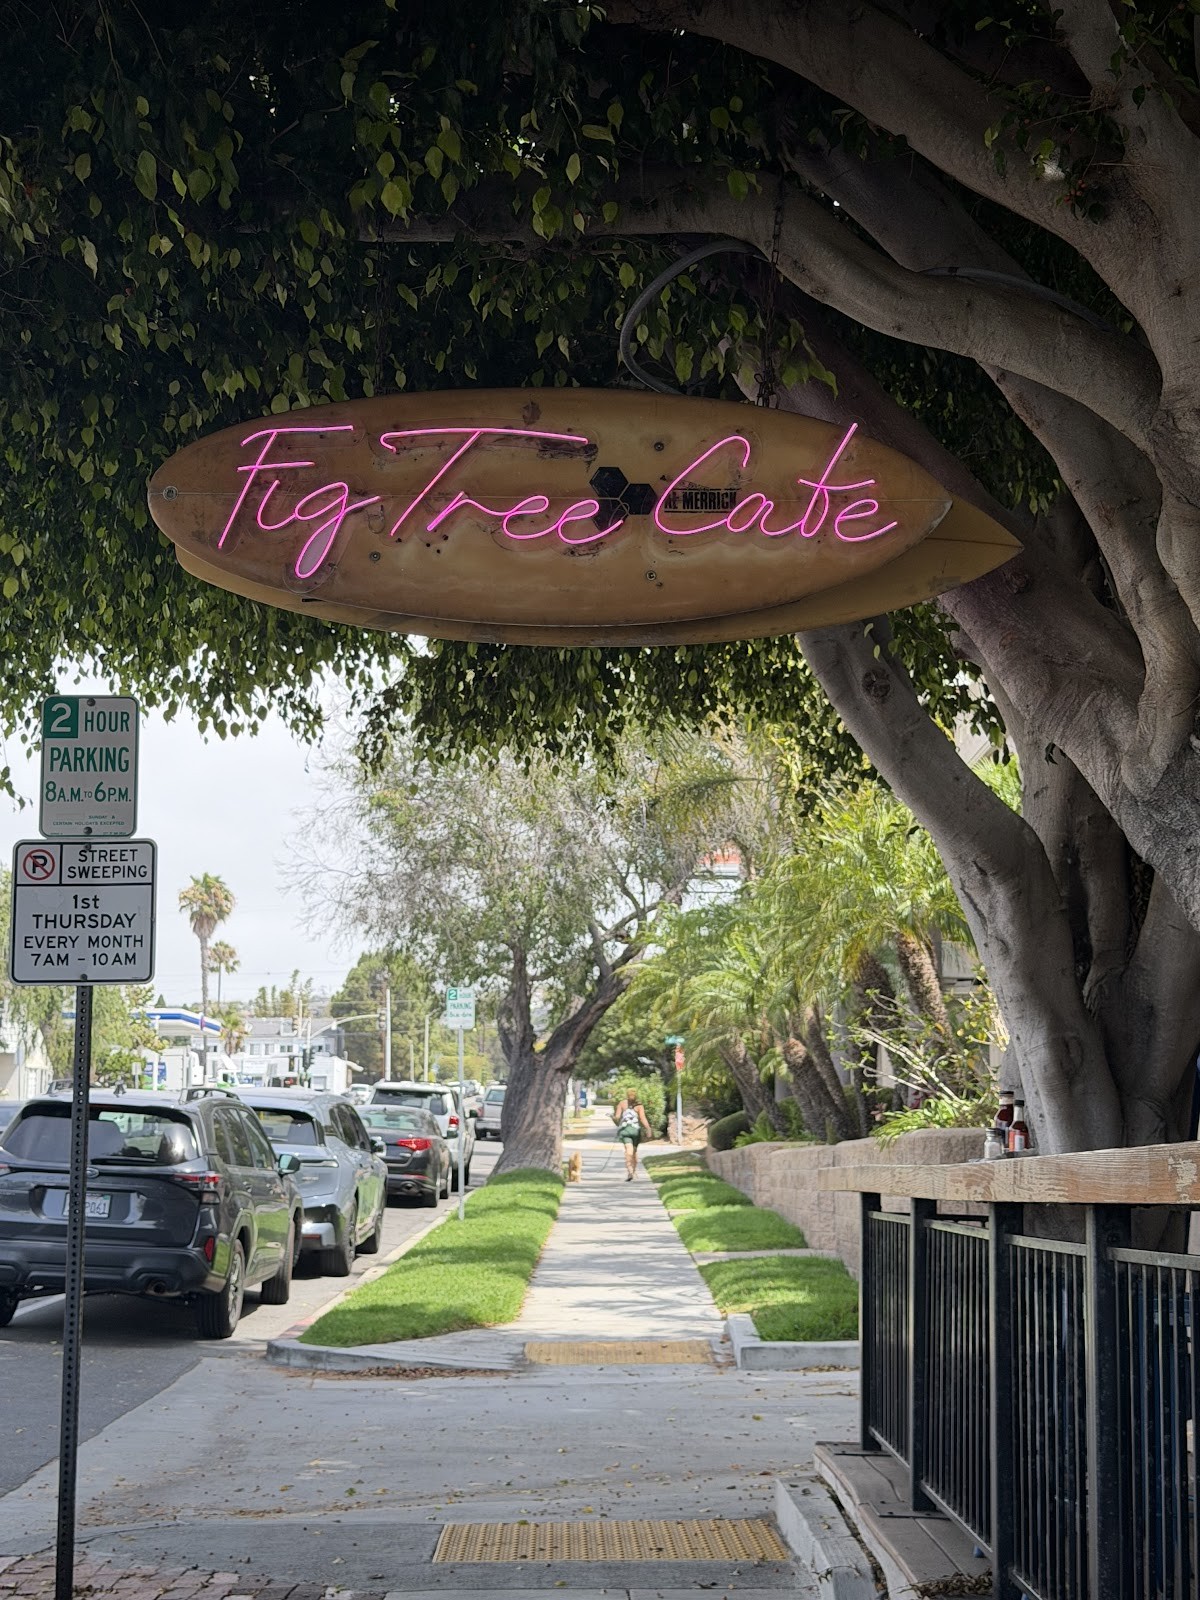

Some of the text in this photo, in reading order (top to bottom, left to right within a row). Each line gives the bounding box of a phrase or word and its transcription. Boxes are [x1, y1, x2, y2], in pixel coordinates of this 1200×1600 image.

[218, 424, 382, 579] Fig
[379, 426, 624, 545] Tree
[682, 491, 736, 510] MERRICK
[50, 702, 130, 733] 2 HOUR
[50, 746, 130, 773] PARKING
[84, 790, 93, 799] TO
[78, 849, 138, 863] STREET
[67, 865, 148, 879] SWEEPING
[72, 894, 100, 910] 1st
[32, 913, 137, 929] THURSDAY
[24, 934, 144, 949] EVERY MONTH
[31, 953, 69, 967] 7AM
[92, 952, 137, 966] 10AM
[449, 989, 457, 1000] 2
